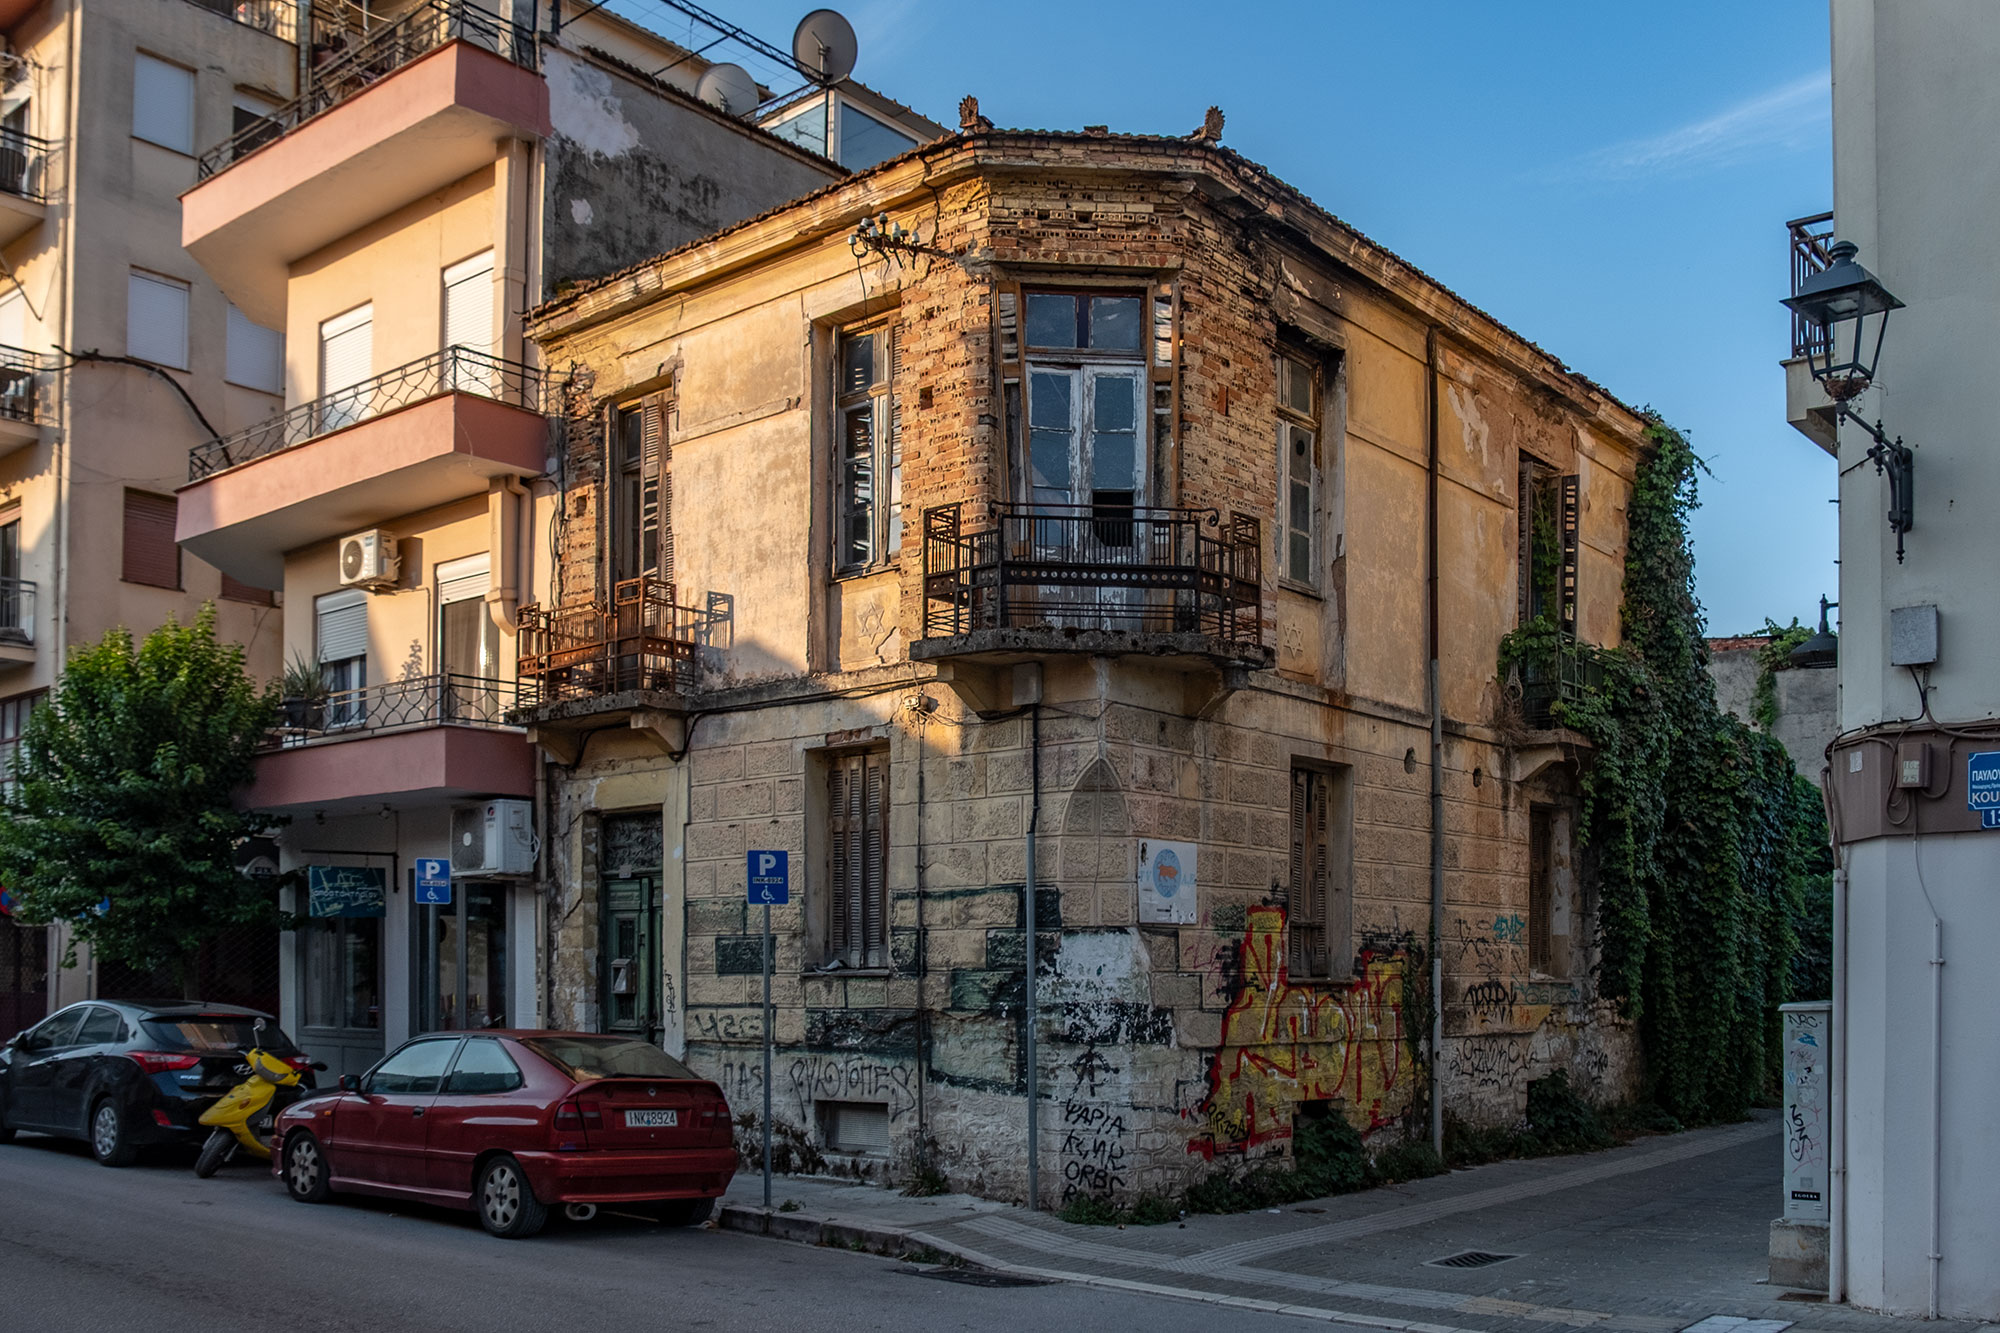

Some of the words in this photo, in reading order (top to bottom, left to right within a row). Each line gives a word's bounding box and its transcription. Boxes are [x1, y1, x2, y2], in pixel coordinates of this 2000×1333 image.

[425, 862, 440, 880] P
[759, 854, 776, 876] P
[650, 1112, 675, 1125] 8924
